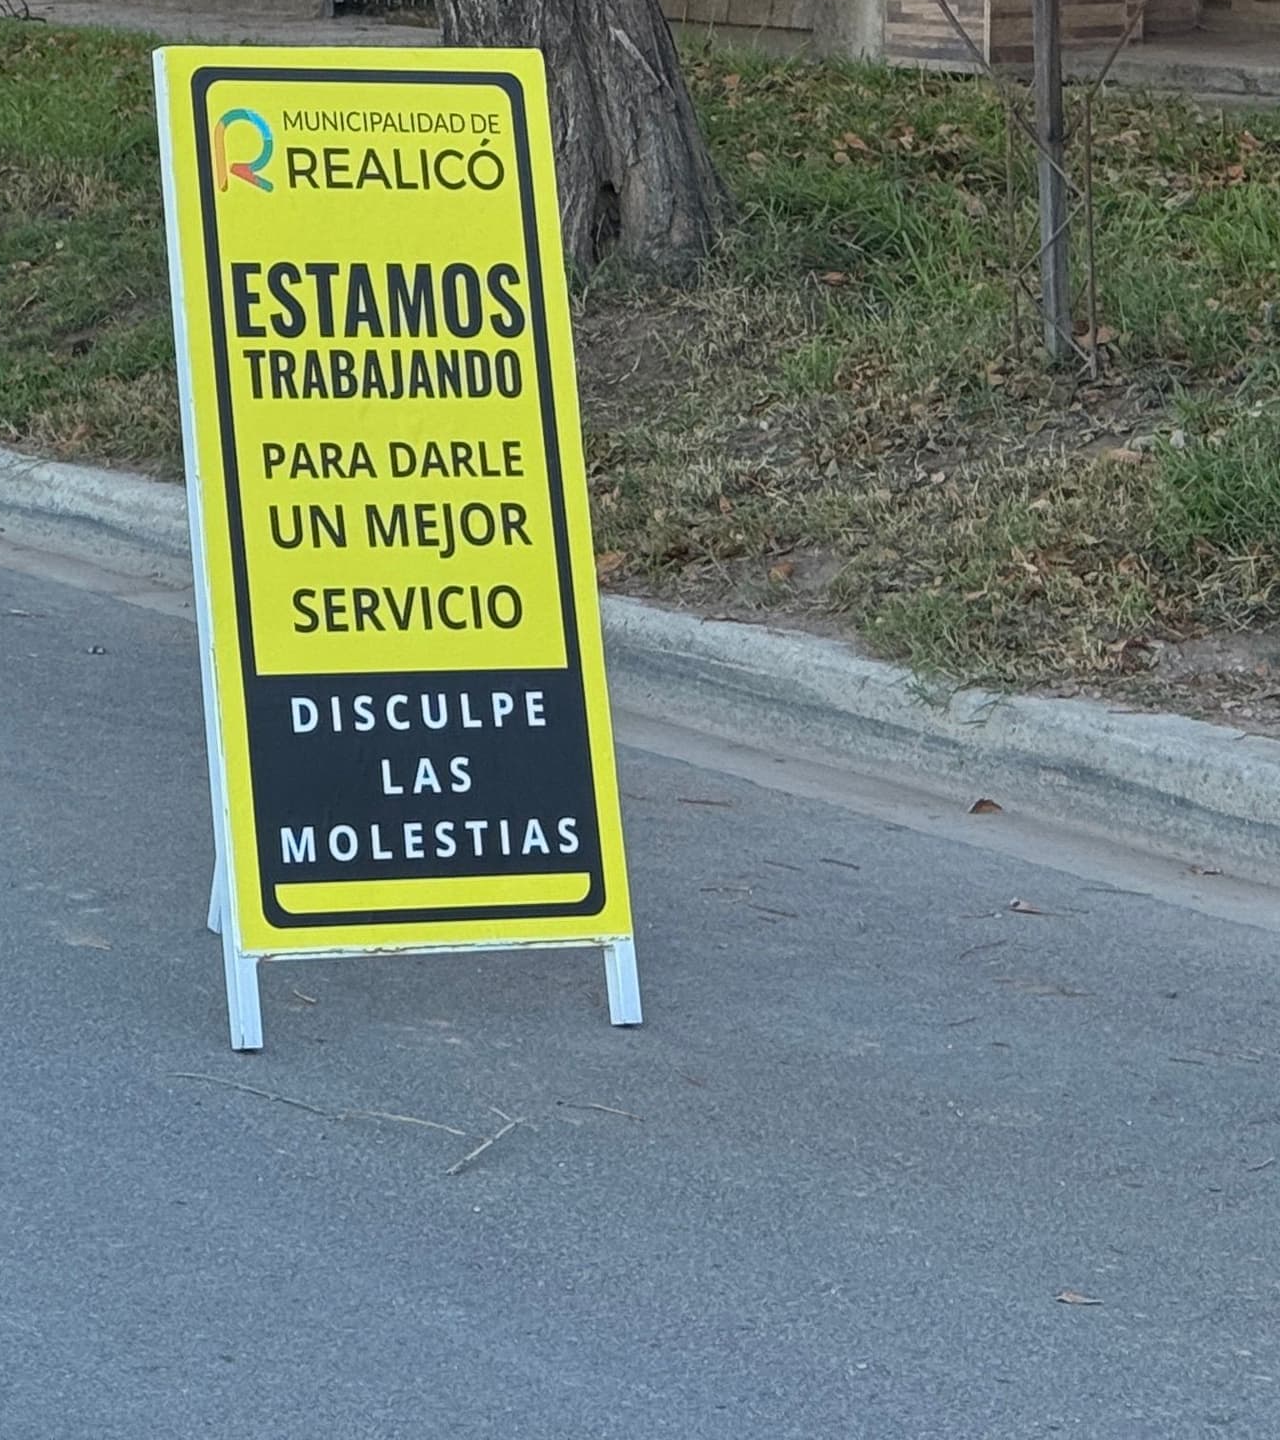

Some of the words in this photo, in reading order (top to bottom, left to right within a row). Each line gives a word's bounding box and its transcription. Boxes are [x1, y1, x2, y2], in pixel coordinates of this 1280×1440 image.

[283, 110, 466, 134] MUNICIPALIDAD
[470, 112, 501, 135] DE
[286, 137, 506, 191] REALICÓ
[230, 261, 526, 340] ESTAMOS
[242, 348, 523, 400] TRABAJANDO
[262, 441, 378, 480] PARA
[388, 440, 525, 478] DARLE
[269, 504, 347, 549] UN
[365, 502, 533, 559] MEJOR
[292, 584, 524, 634] SERVICIO
[291, 691, 546, 733] DISCULPE
[381, 756, 472, 795] LAS
[280, 817, 580, 864] MOLESTIAS
